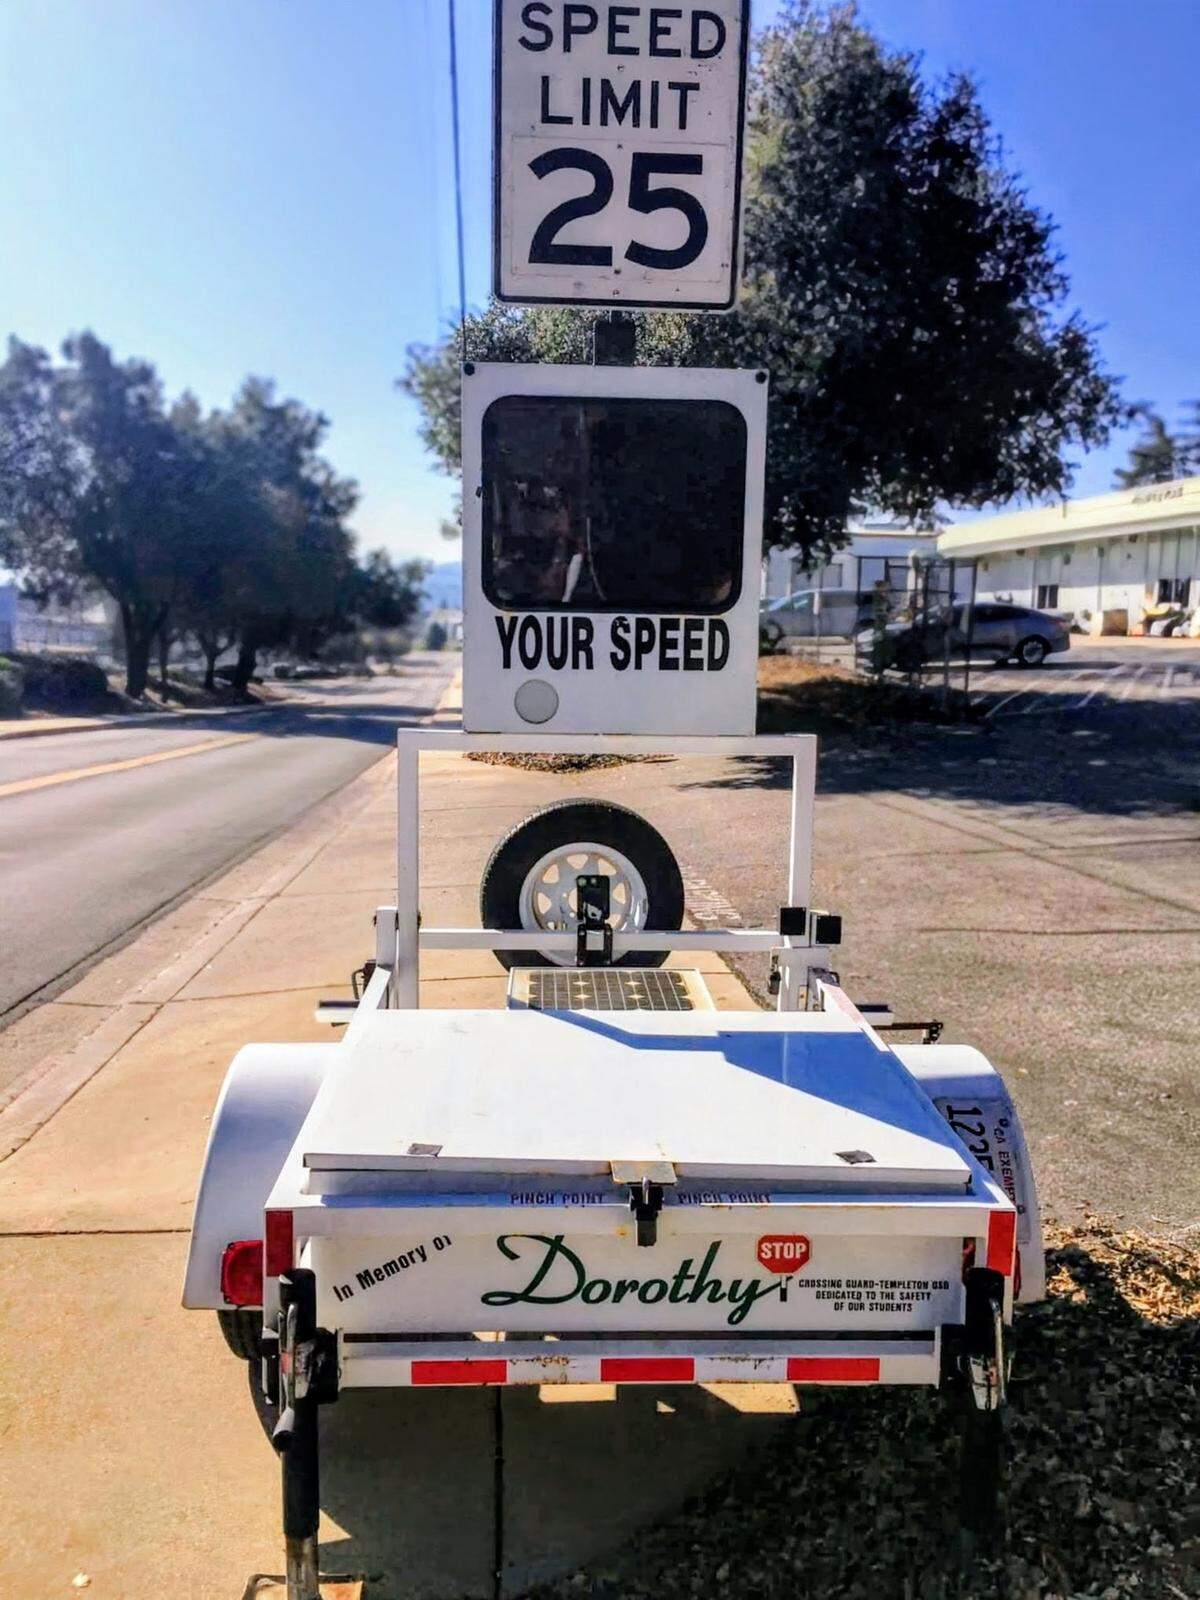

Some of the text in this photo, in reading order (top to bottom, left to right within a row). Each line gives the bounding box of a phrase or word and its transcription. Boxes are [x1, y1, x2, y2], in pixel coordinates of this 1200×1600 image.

[518, 2, 726, 59] SPEED
[541, 76, 700, 130] LIMIT
[527, 147, 709, 270] 25
[494, 615, 731, 671] YOUR SPEED
[510, 1192, 604, 1204] PINCH POINT
[333, 1284, 354, 1303] In
[356, 1244, 427, 1290] Memory
[760, 1242, 806, 1259] STOP
[481, 1234, 784, 1325] Dorothy
[799, 1279, 842, 1289] CROSSING
[815, 1290, 932, 1301] DEDICATED TO THE SAFETY
[834, 1302, 913, 1312] OF OUR STUDENTS
